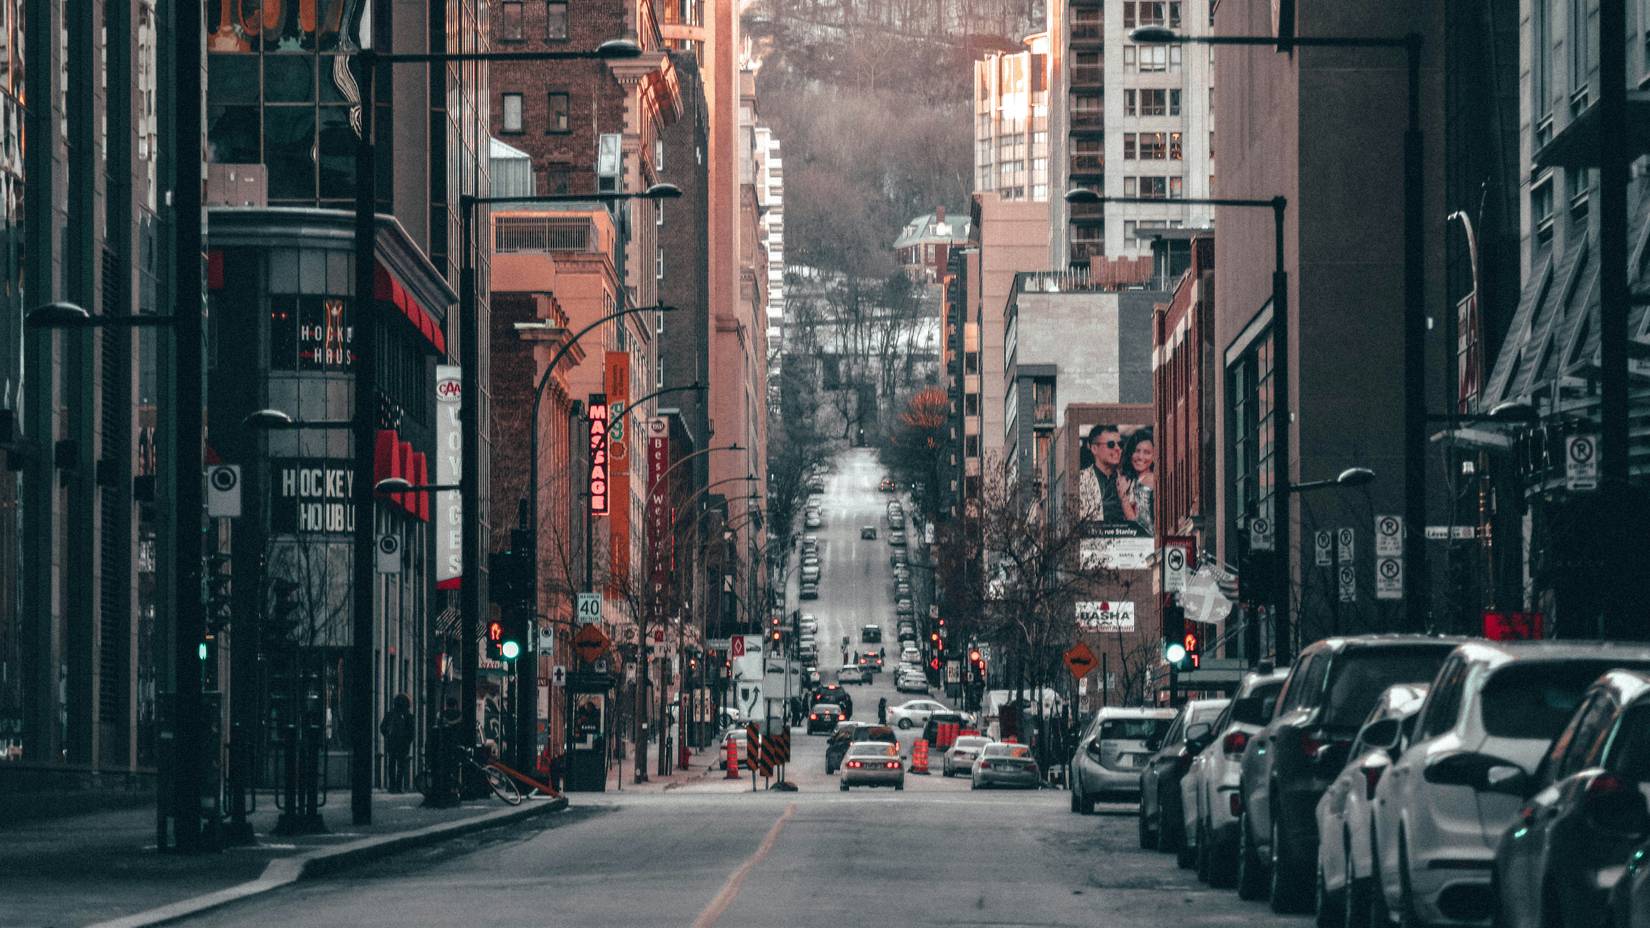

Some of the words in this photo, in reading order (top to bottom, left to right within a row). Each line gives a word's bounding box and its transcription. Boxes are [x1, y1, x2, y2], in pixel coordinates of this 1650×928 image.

[438, 380, 461, 396] CAA
[589, 404, 606, 511] MASSAGE
[282, 468, 354, 498] HOCKEY
[1115, 527, 1137, 536] Stanley
[580, 599, 599, 616] 40
